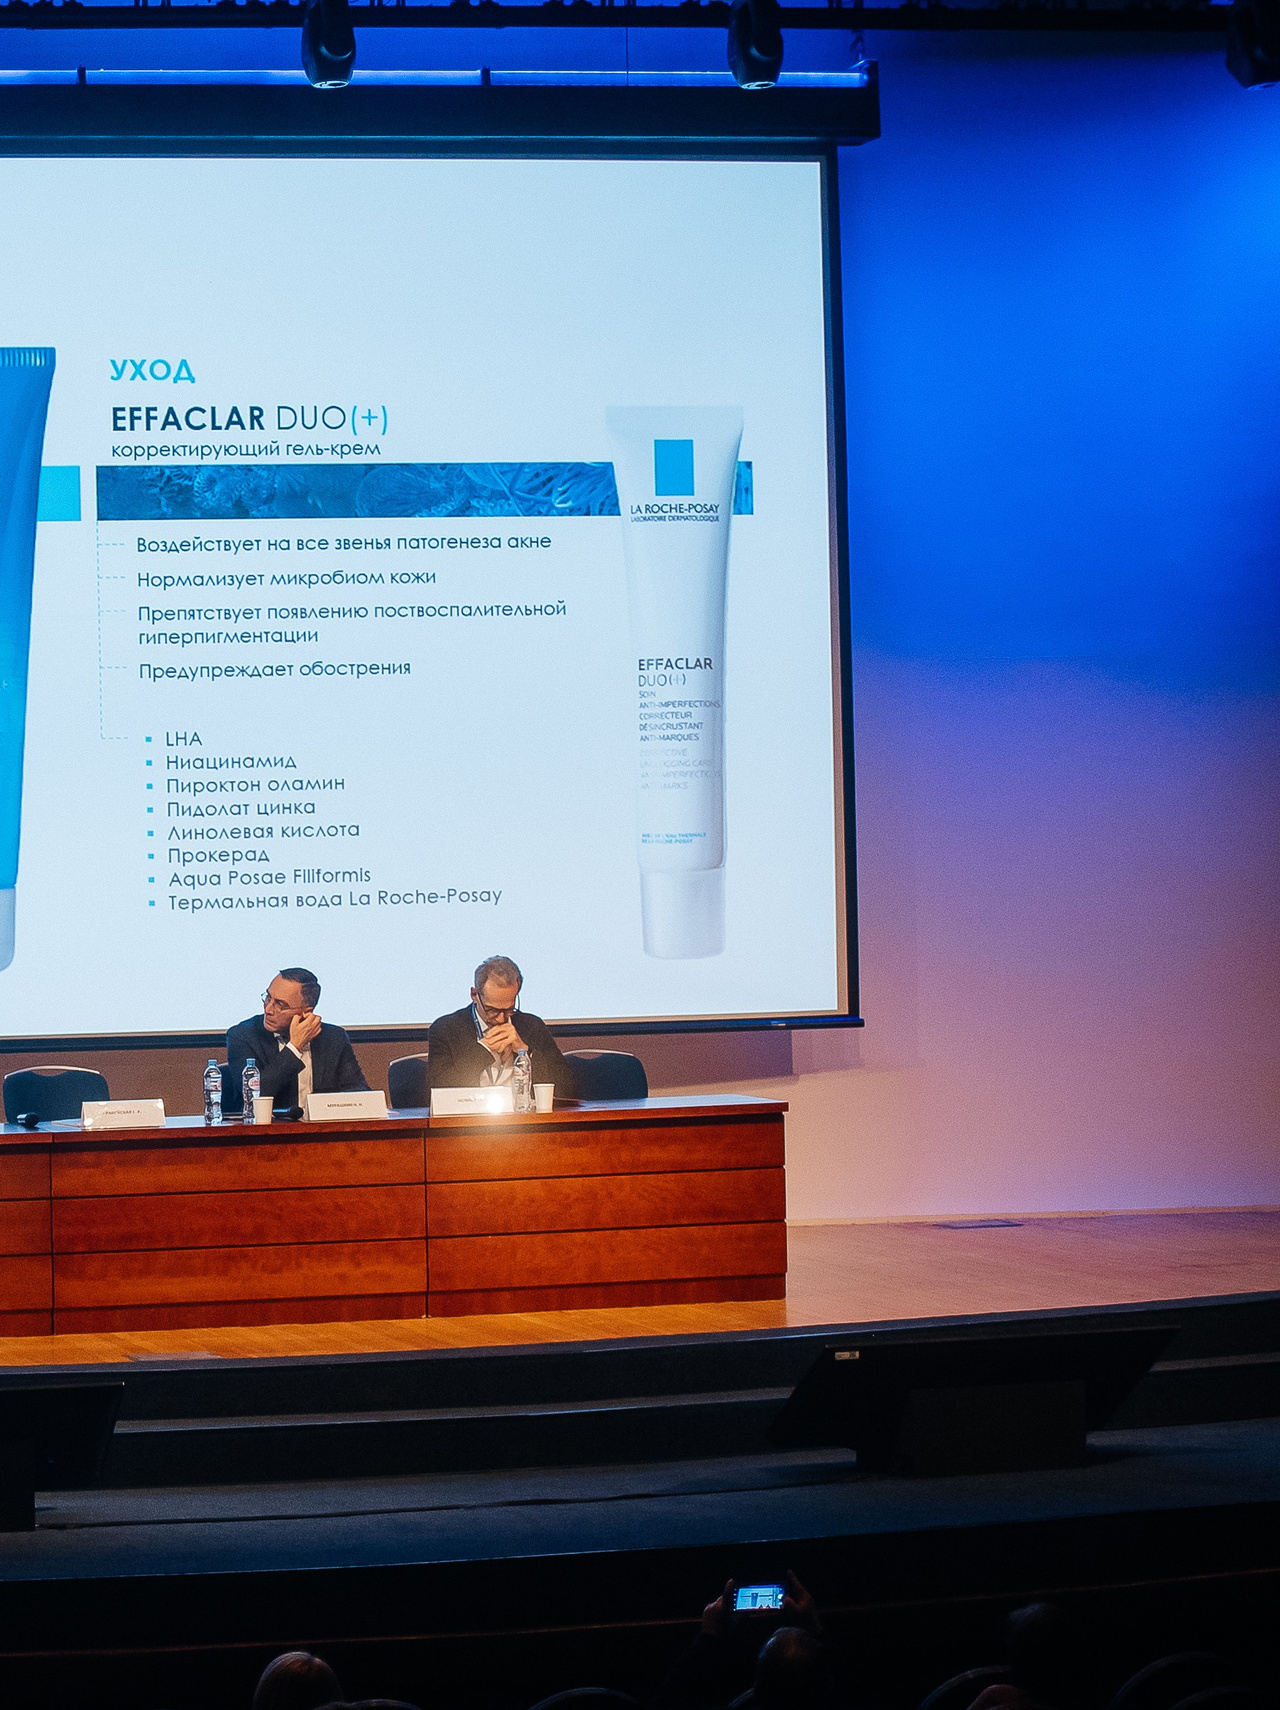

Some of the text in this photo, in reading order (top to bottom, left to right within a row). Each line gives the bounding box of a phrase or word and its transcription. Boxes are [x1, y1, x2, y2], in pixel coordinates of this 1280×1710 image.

[109, 358, 196, 384] УХОД
[112, 405, 388, 436] EFFACLAR DUO(+)
[111, 440, 381, 462] корректирующий гель-крем
[631, 503, 720, 514] LA ROCHE-POSAY
[137, 536, 552, 556] Воздействует на все звенья патогенеза акне
[137, 569, 436, 591] Нормализует микробиом кожи
[138, 599, 567, 626] Препятствует появлению поствоспалительной
[139, 630, 319, 648] гиперпигментации
[139, 660, 411, 683] Предупреждает обострения
[638, 658, 713, 671] EFFACLAR
[638, 673, 687, 687] DUO(+)
[166, 731, 203, 747] LHA
[166, 755, 297, 771] Ниацинамид
[166, 778, 345, 797] Пироктон оламин
[167, 801, 316, 818] Пидолат цинка
[167, 824, 360, 841] Линолевая кислота
[168, 847, 270, 867] Прокерад
[168, 872, 221, 891] Aqua
[228, 870, 287, 886] Posae
[168, 888, 503, 914] Термальная вода La Roche-Posay
